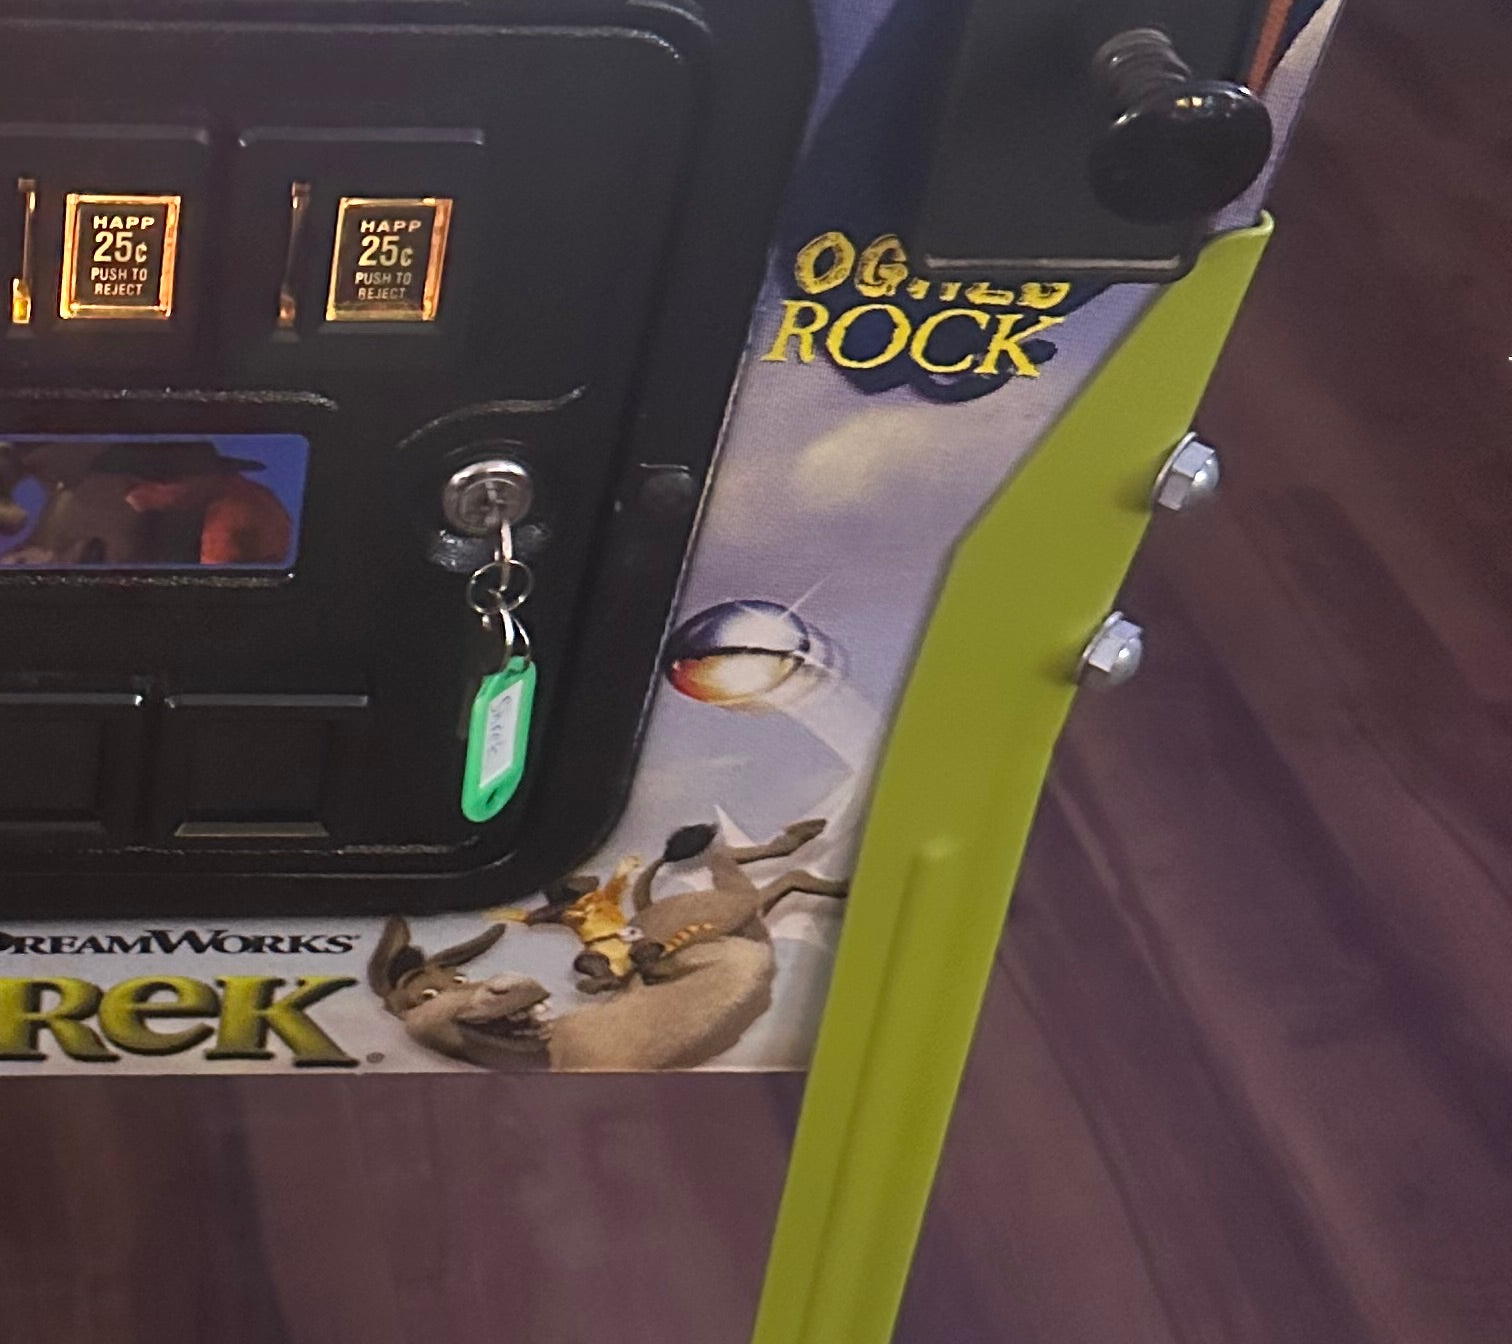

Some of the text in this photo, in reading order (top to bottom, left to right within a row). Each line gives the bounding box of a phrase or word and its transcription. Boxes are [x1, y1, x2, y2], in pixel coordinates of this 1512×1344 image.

[92, 214, 156, 230] HAPP
[359, 219, 423, 234] HAPP
[92, 230, 149, 264] 25¢
[90, 266, 149, 282] PUSH TO
[354, 271, 413, 286] PUSH TO
[93, 282, 144, 296] REJECT
[357, 286, 407, 301] REJECT
[760, 298, 1066, 378] ROCK
